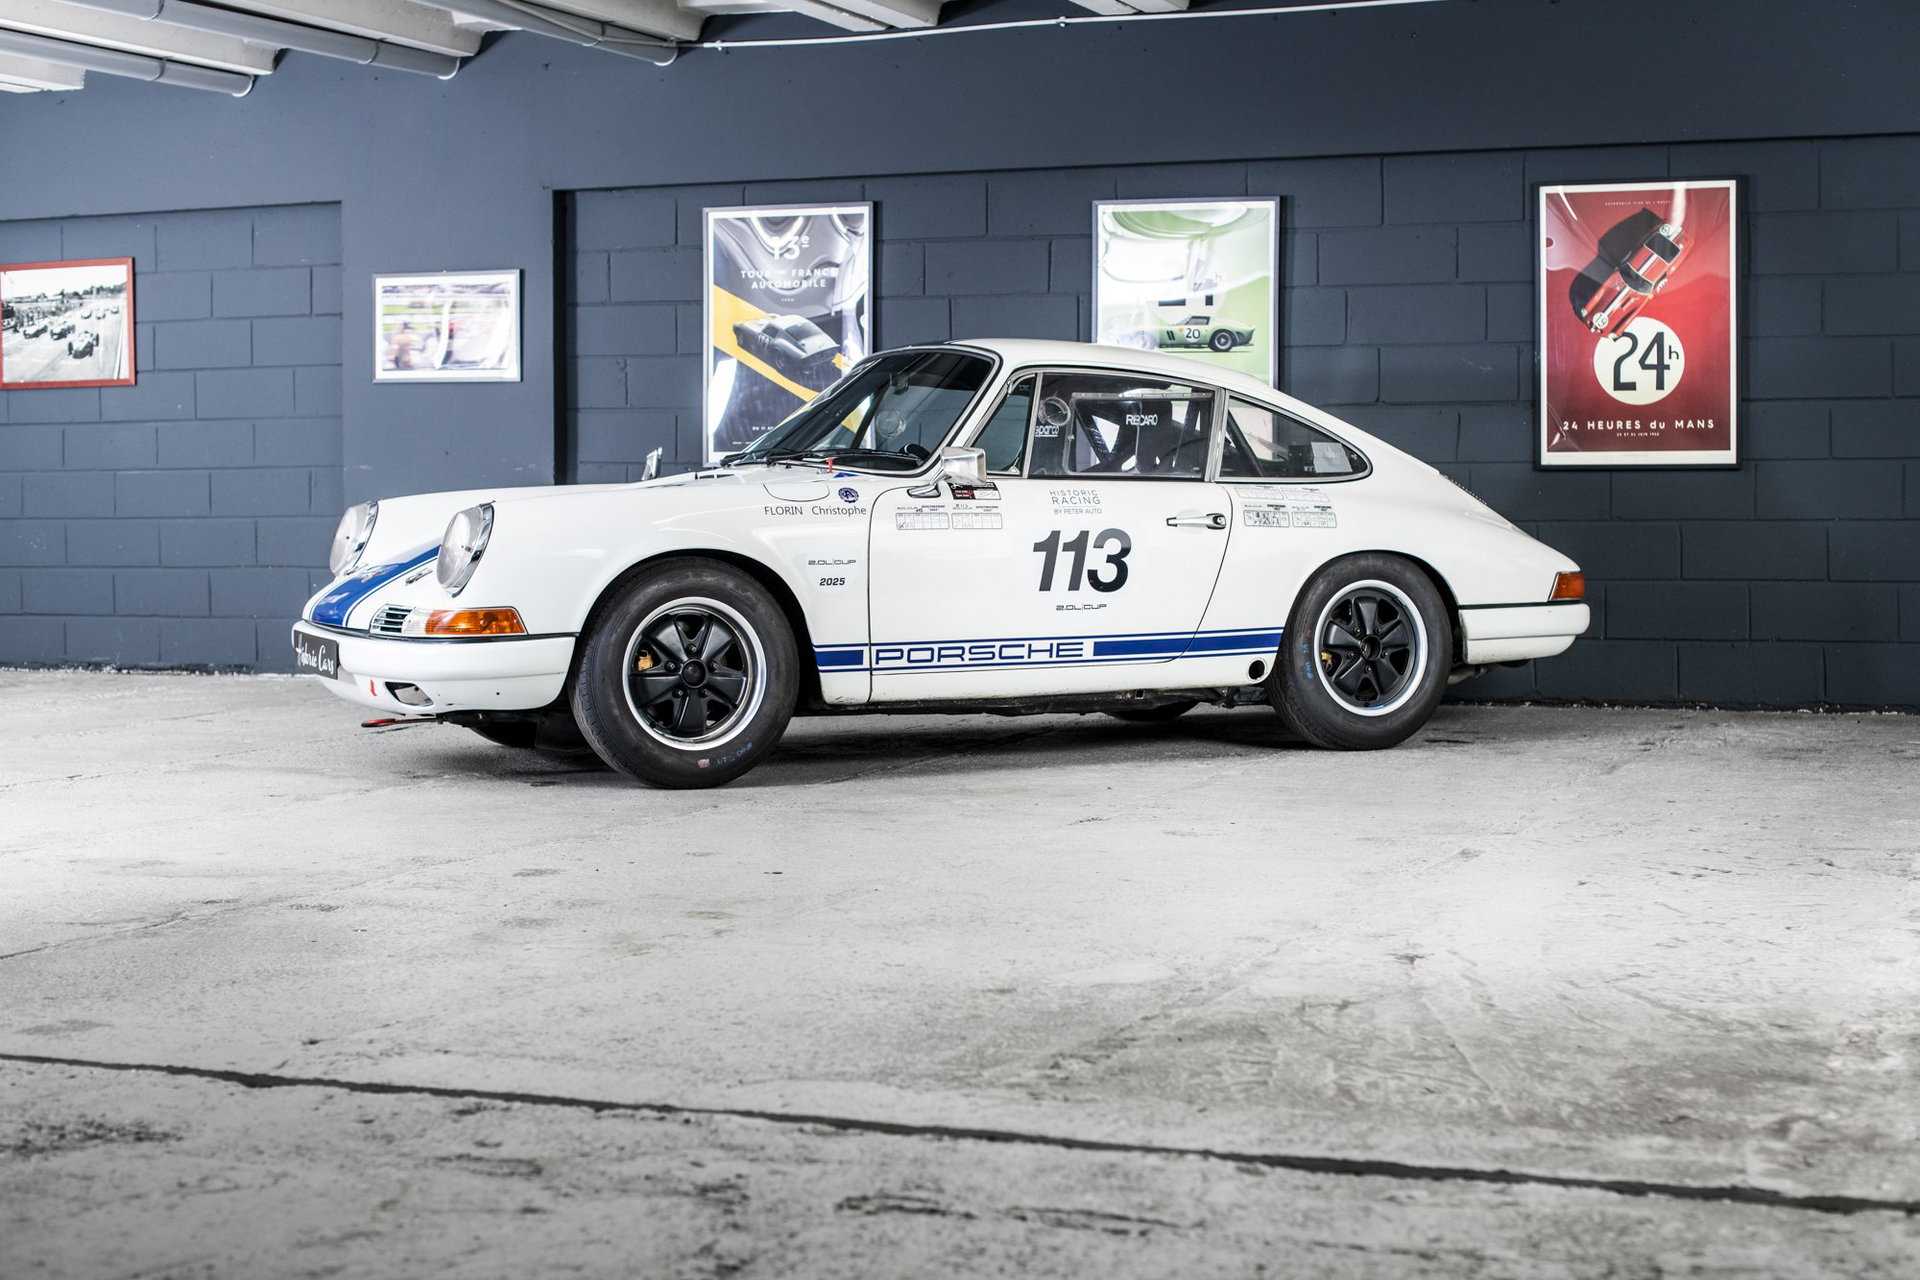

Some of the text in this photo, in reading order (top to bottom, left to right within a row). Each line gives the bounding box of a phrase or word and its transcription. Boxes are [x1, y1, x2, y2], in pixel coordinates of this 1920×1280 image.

[751, 279, 826, 289] AUTOMOBILE
[1186, 328, 1201, 339] 20
[1126, 413, 1158, 426] RECARO
[1563, 419, 1715, 430] 24 HEURES du MANS
[1052, 496, 1101, 505] RACING
[764, 505, 867, 517] FLORIN Christophe
[1033, 528, 1132, 593] 113
[819, 578, 846, 586] 2025
[875, 641, 1084, 665] PORSCHE
[318, 644, 334, 675] Cars
